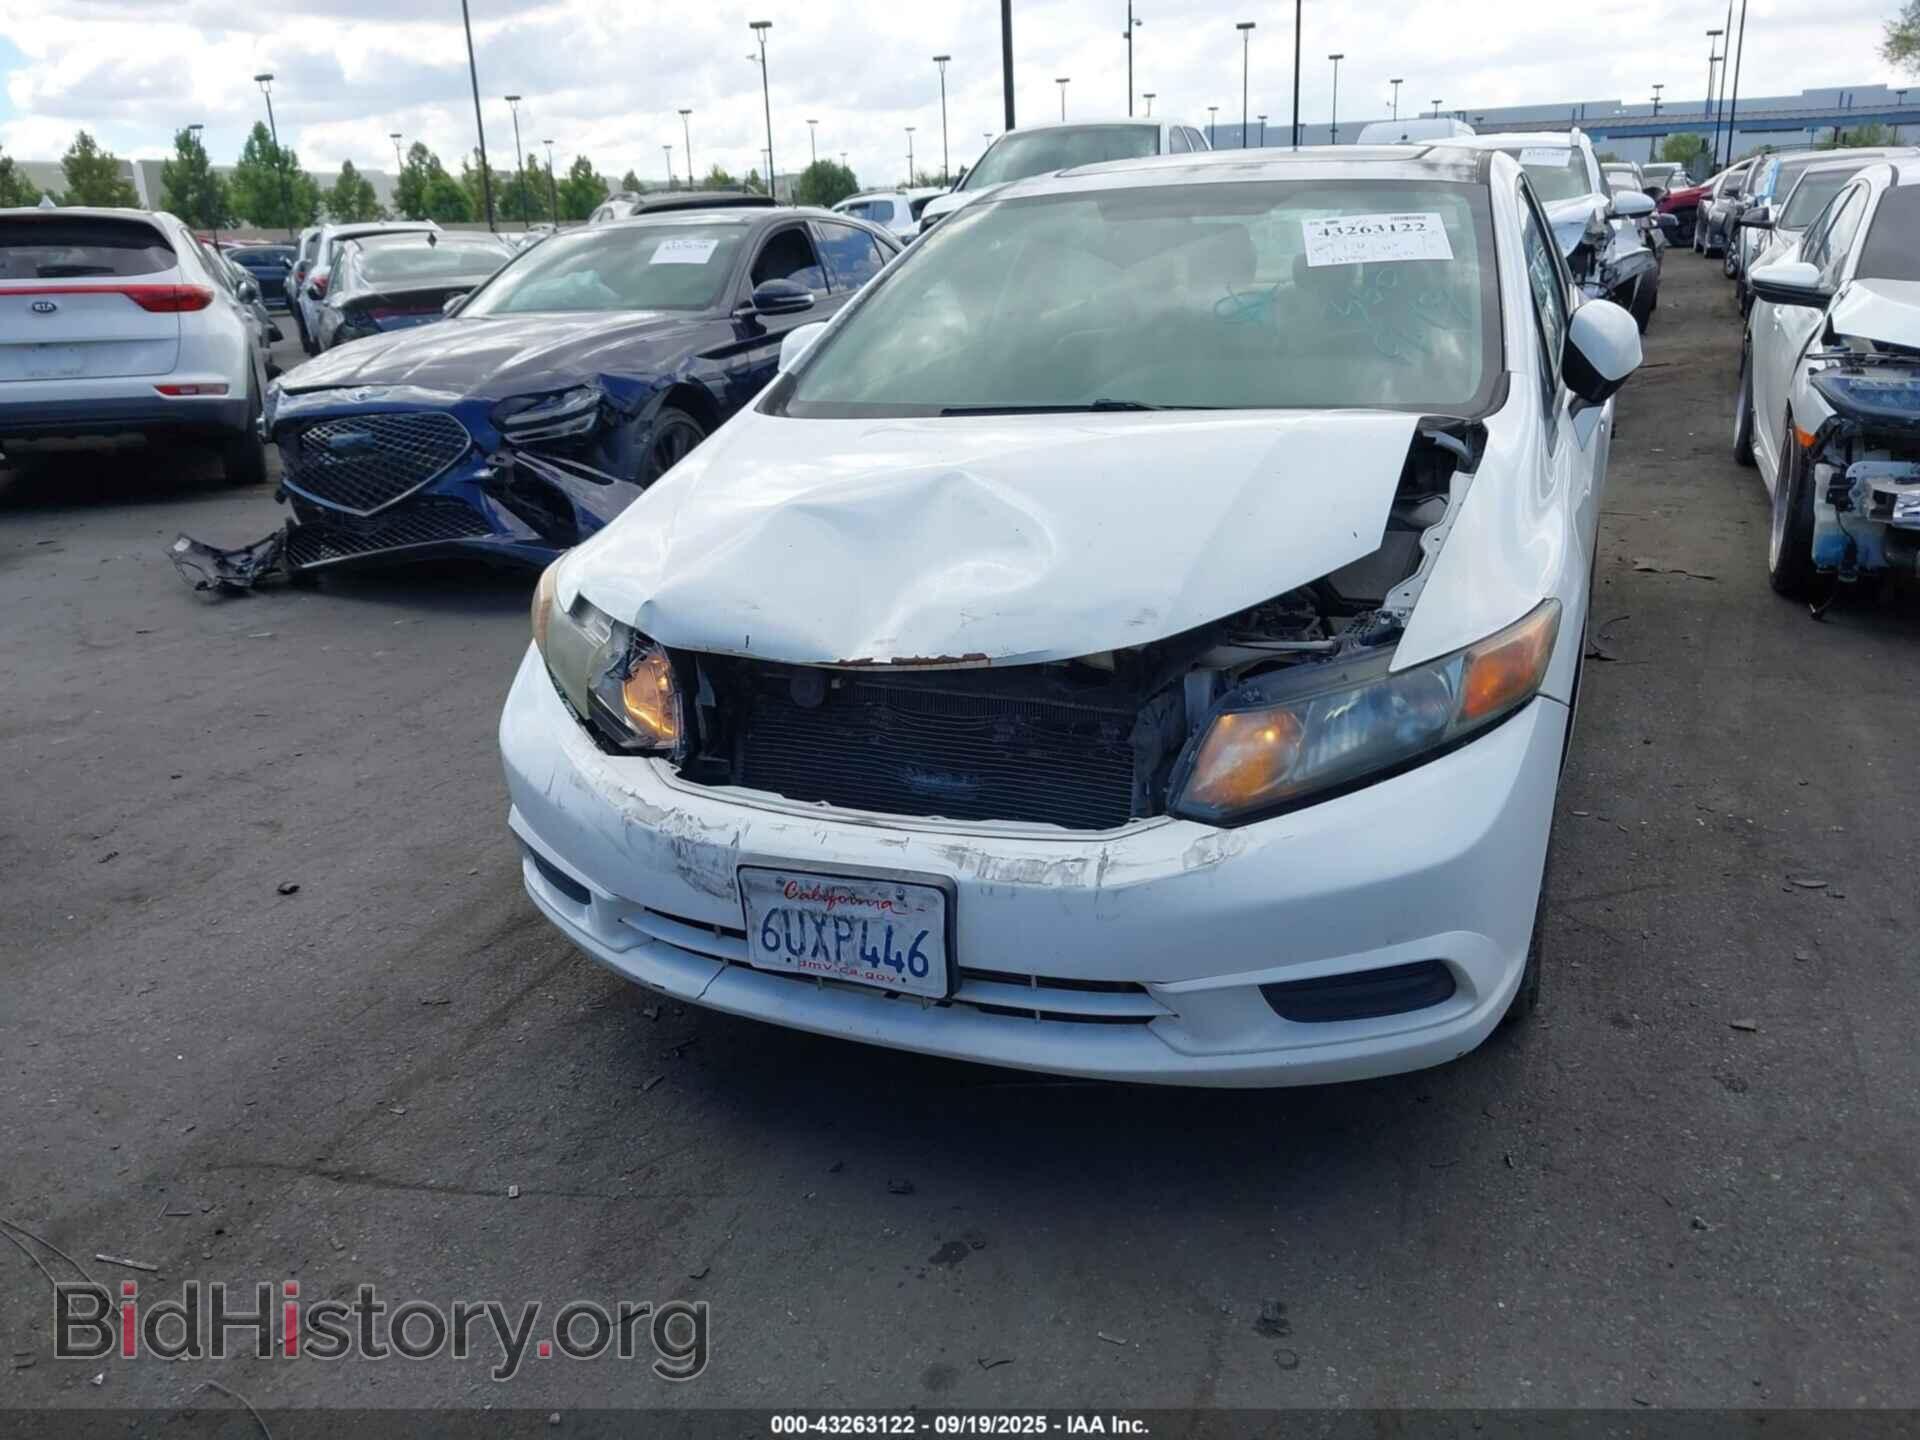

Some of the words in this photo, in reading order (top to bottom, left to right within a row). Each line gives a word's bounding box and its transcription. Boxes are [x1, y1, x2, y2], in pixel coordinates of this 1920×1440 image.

[1317, 223, 1427, 237] 43263122
[784, 879, 898, 911] California
[761, 907, 930, 978] 6UXP446
